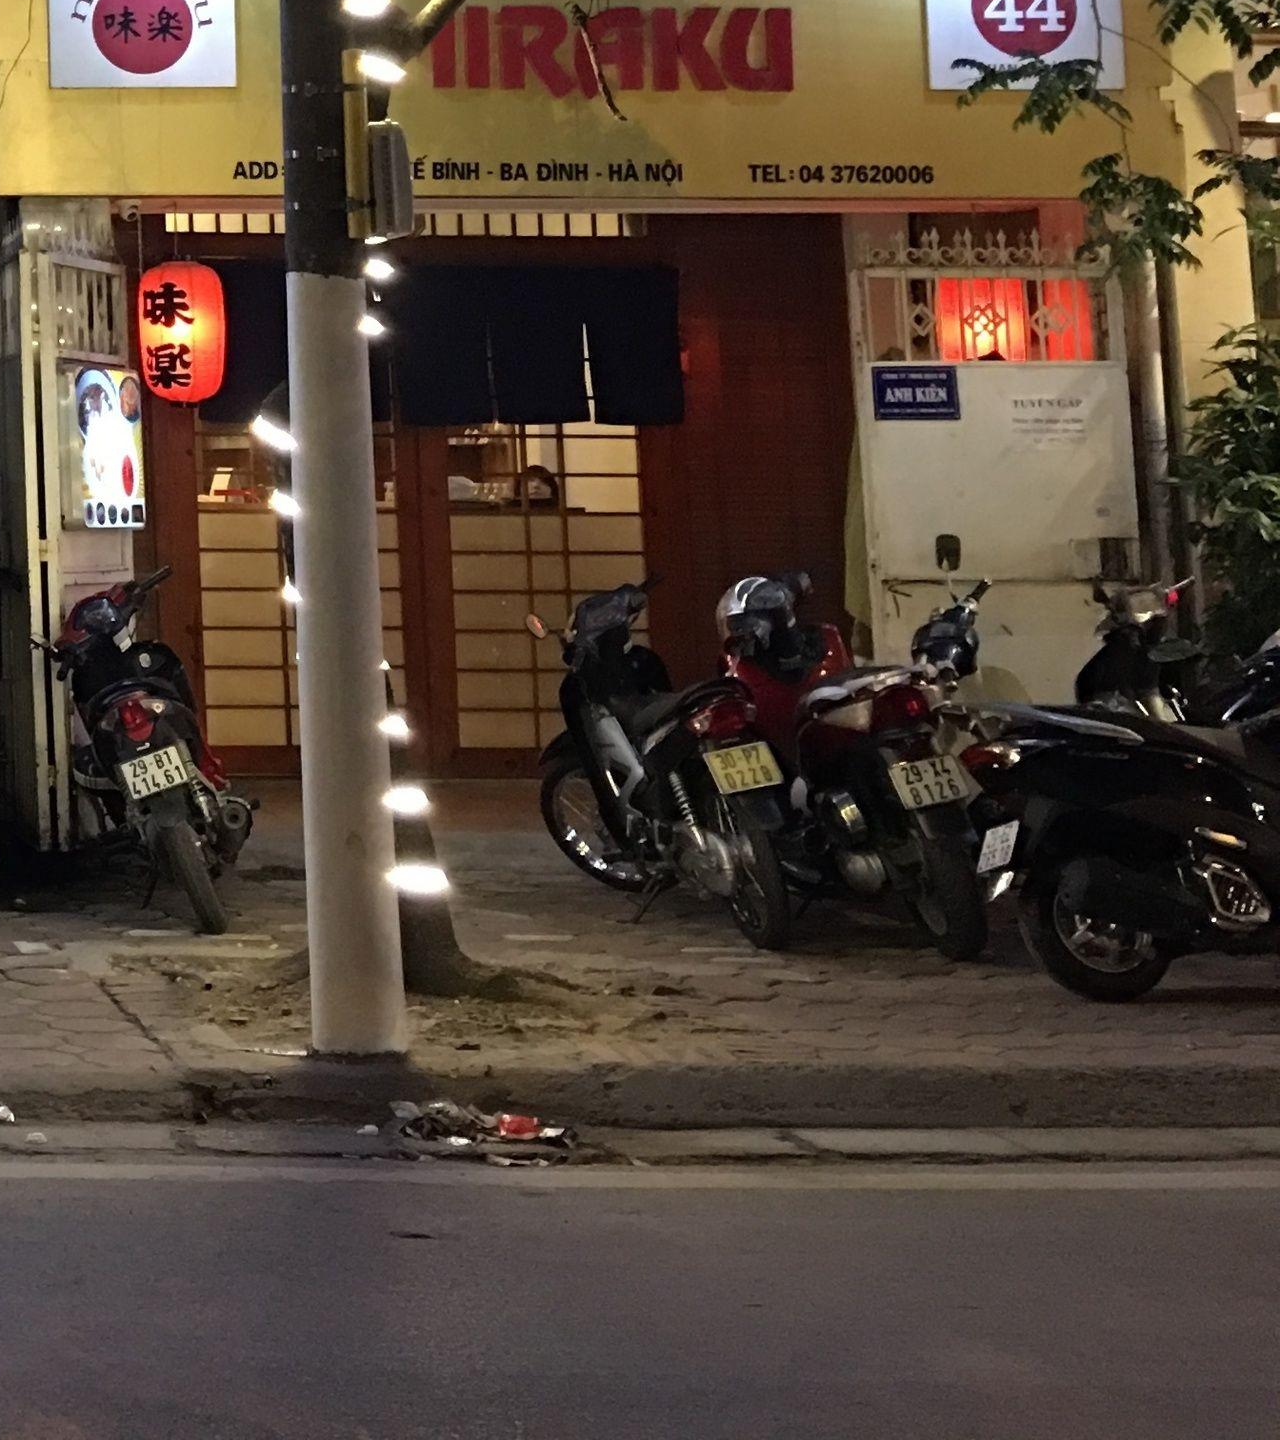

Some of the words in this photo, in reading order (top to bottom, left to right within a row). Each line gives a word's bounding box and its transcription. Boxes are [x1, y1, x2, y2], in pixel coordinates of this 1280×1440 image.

[103, 6, 184, 44] 味楽
[500, 163, 529, 181] BA
[537, 158, 589, 182] ĐÌNH
[608, 159, 639, 182] HÀ
[645, 159, 683, 187] NỘI
[799, 165, 825, 183] 04
[831, 165, 934, 184] 37620006
[143, 282, 194, 389] 味楽
